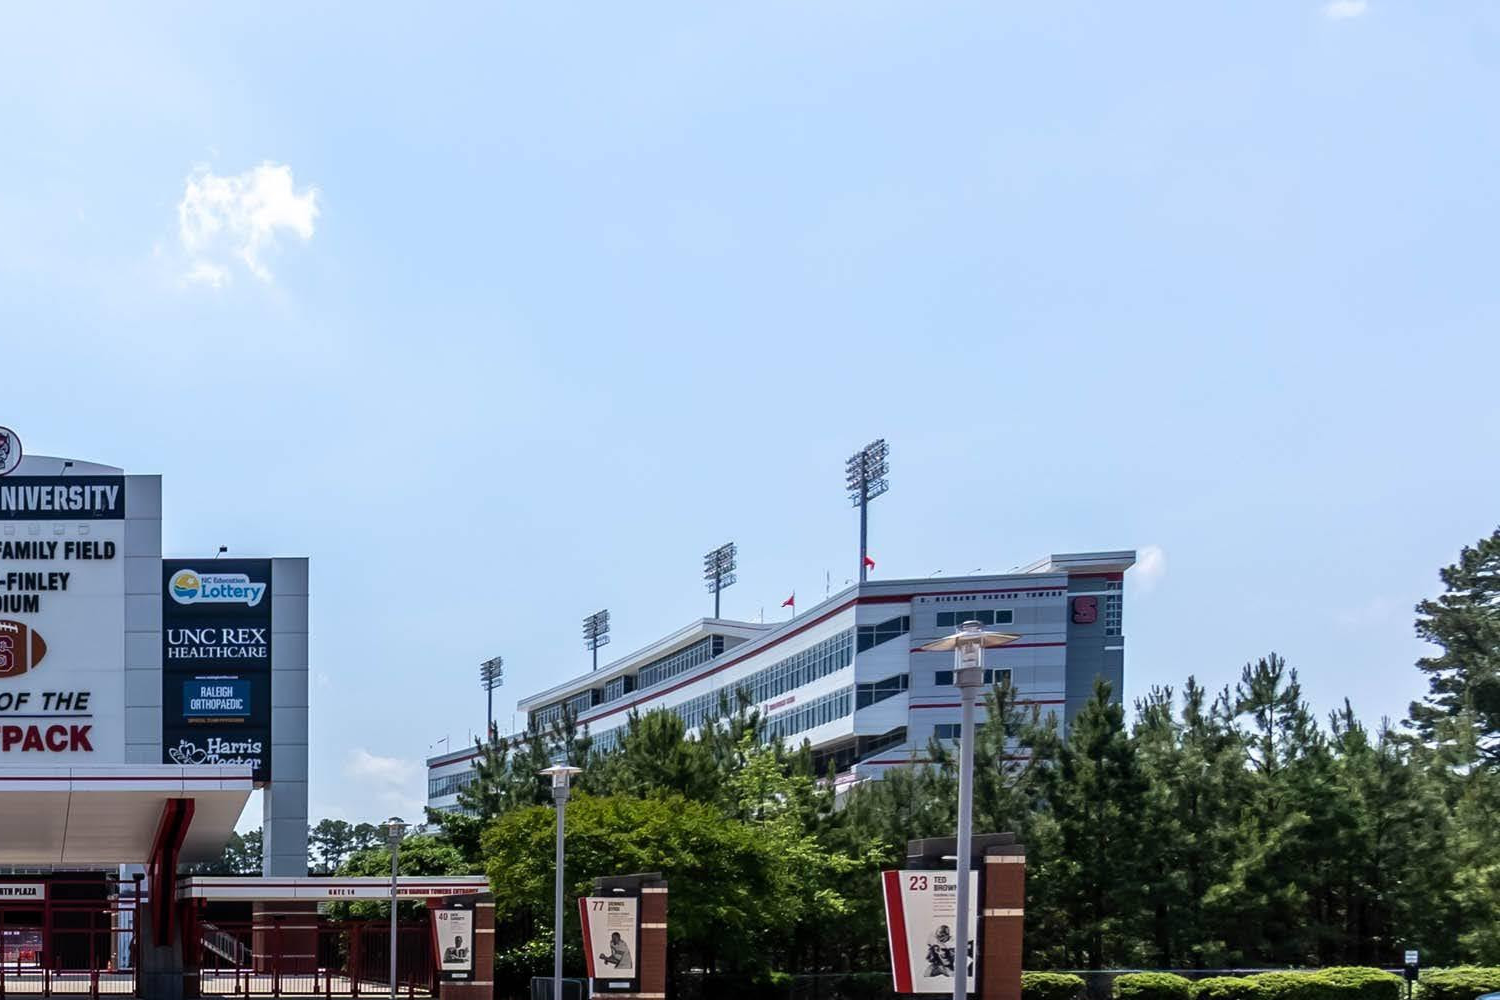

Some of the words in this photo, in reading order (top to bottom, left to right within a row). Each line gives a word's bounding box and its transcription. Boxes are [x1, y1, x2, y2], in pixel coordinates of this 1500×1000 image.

[64, 542, 116, 560] FIELD
[201, 585, 260, 601] Lottery
[167, 629, 215, 644] UNC
[222, 629, 267, 644] REX
[168, 647, 267, 658] HEALTHCARE
[201, 687, 233, 697] RALEIGH
[41, 693, 90, 710] THE
[191, 699, 243, 709] ORTHOPAEDIC
[207, 738, 261, 753] Harris
[910, 876, 928, 890] 23
[593, 901, 604, 911] 77
